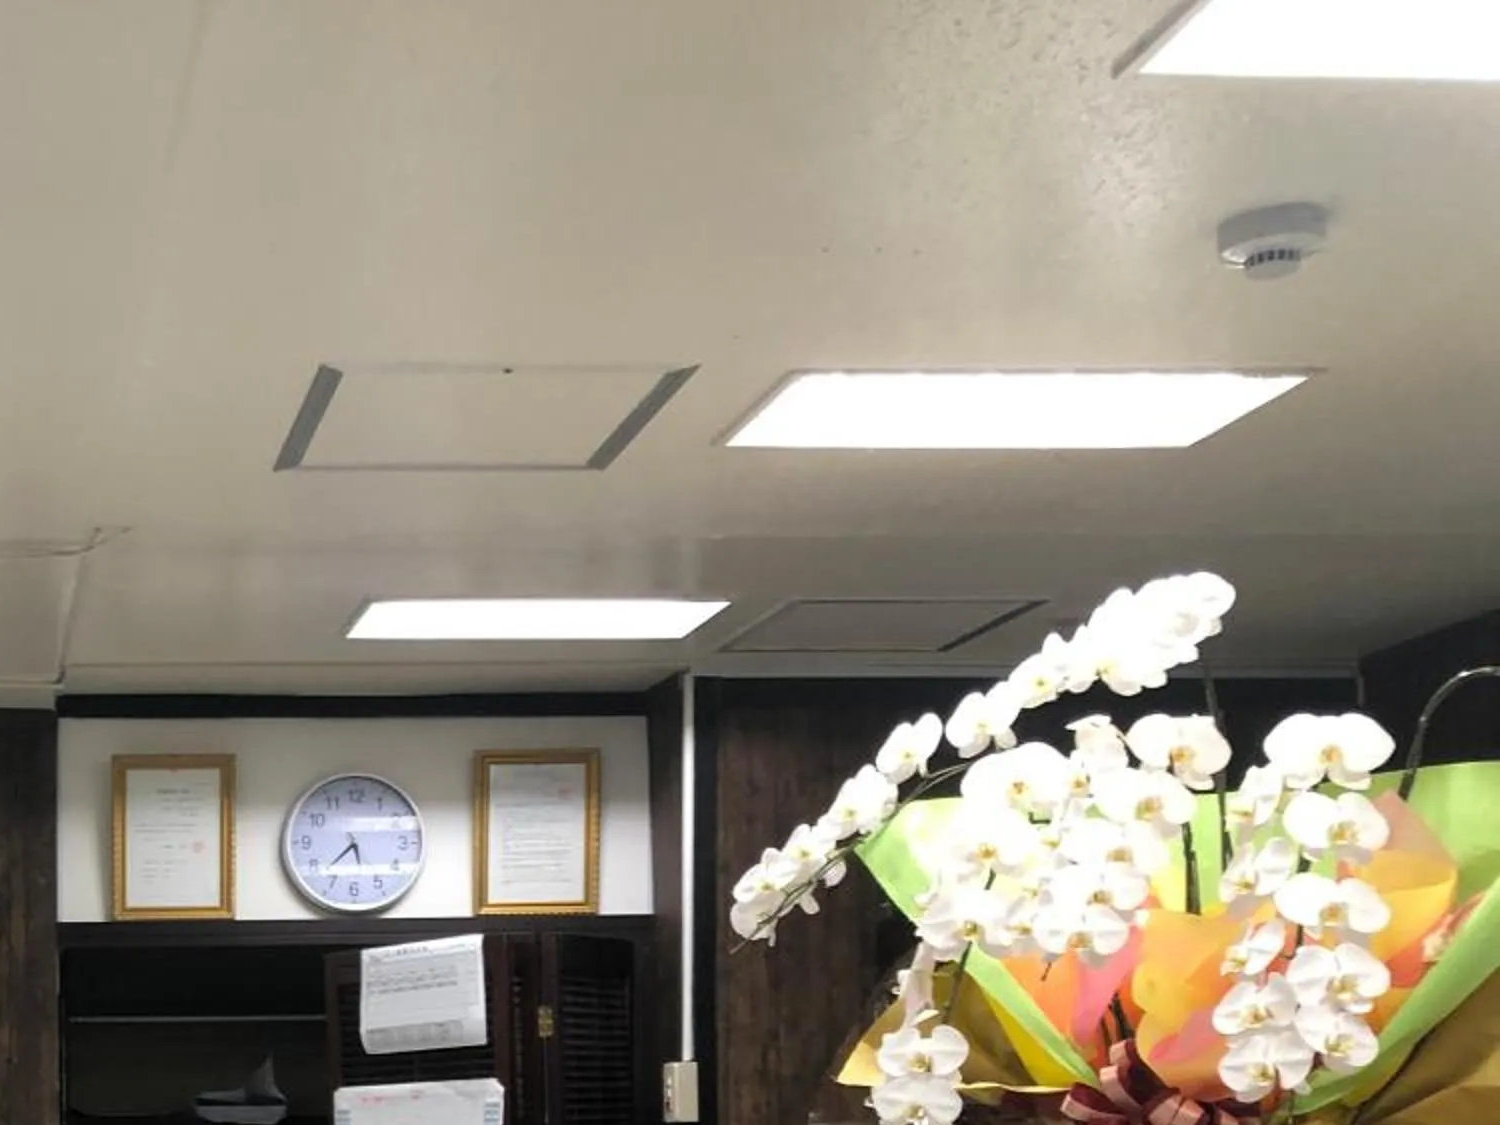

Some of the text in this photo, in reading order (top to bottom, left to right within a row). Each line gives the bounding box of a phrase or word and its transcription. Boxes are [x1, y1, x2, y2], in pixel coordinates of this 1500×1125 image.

[347, 787, 365, 803] 12
[325, 796, 341, 811] 11
[376, 796, 383, 811] 1
[309, 812, 326, 828] 10
[301, 834, 312, 850] 9
[397, 835, 408, 850] 3
[327, 874, 338, 889] 7
[349, 881, 359, 896] 6
[373, 875, 383, 889] 5
